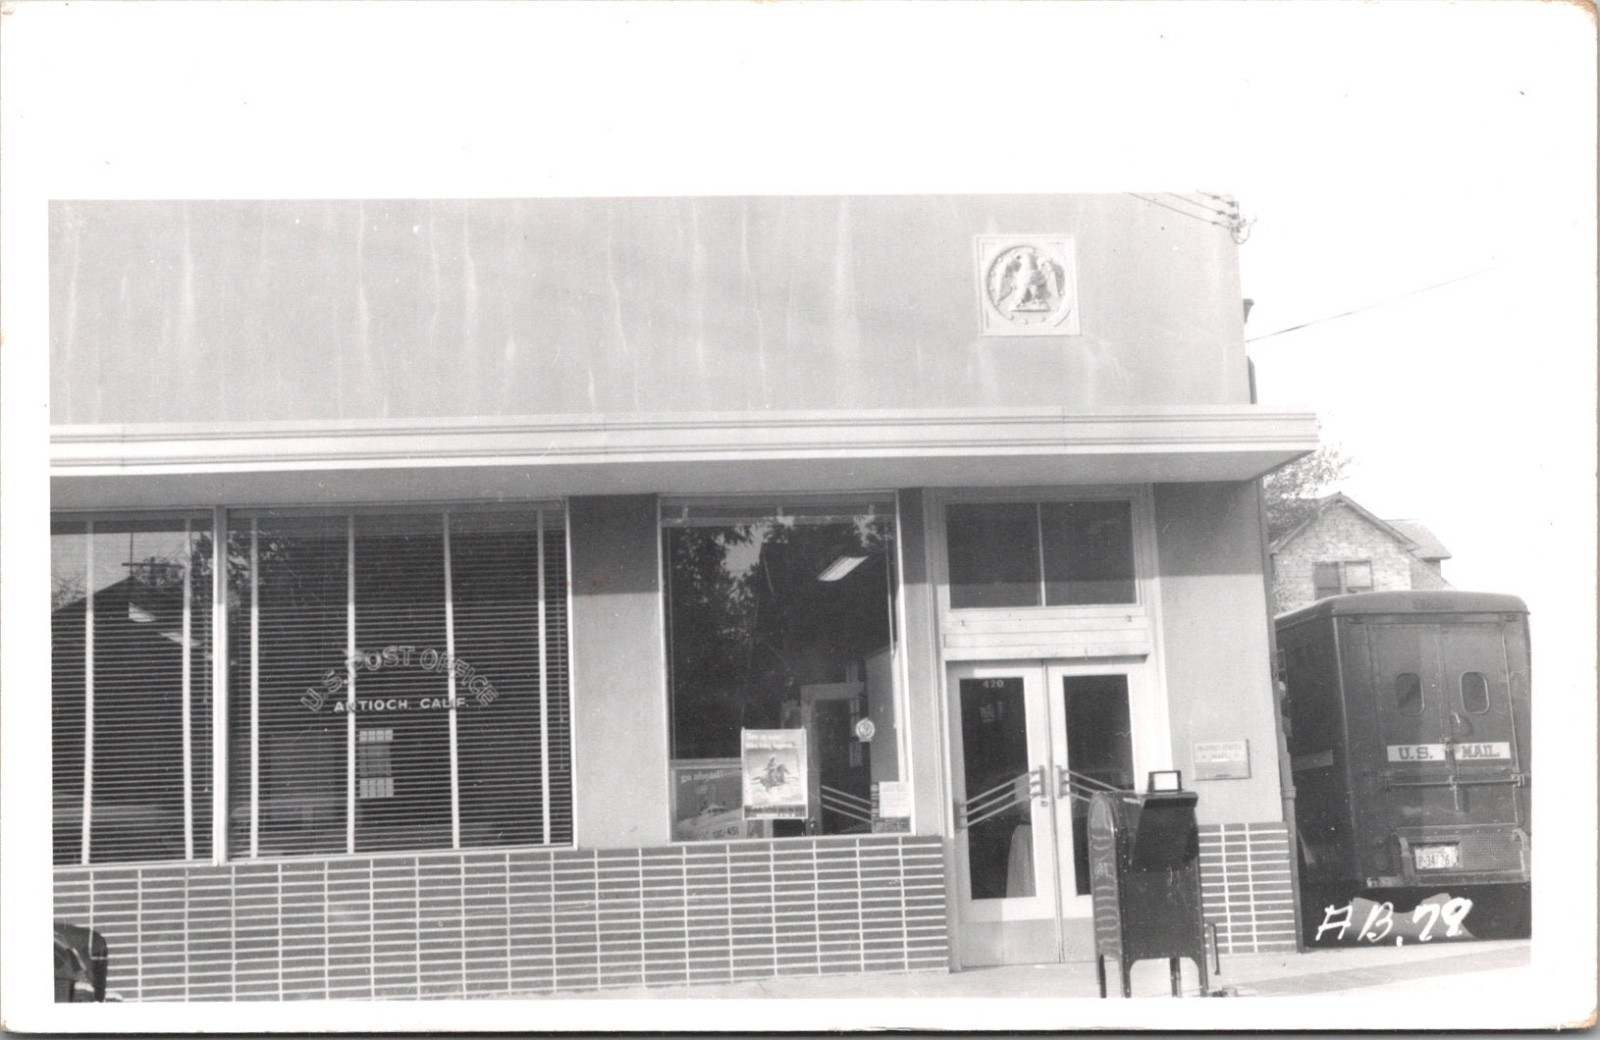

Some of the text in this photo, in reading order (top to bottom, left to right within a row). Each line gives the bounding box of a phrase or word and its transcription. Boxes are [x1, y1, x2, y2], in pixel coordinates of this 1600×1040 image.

[344, 645, 415, 678] POST
[420, 648, 500, 707] OFFICE
[1398, 746, 1434, 760] U.S.
